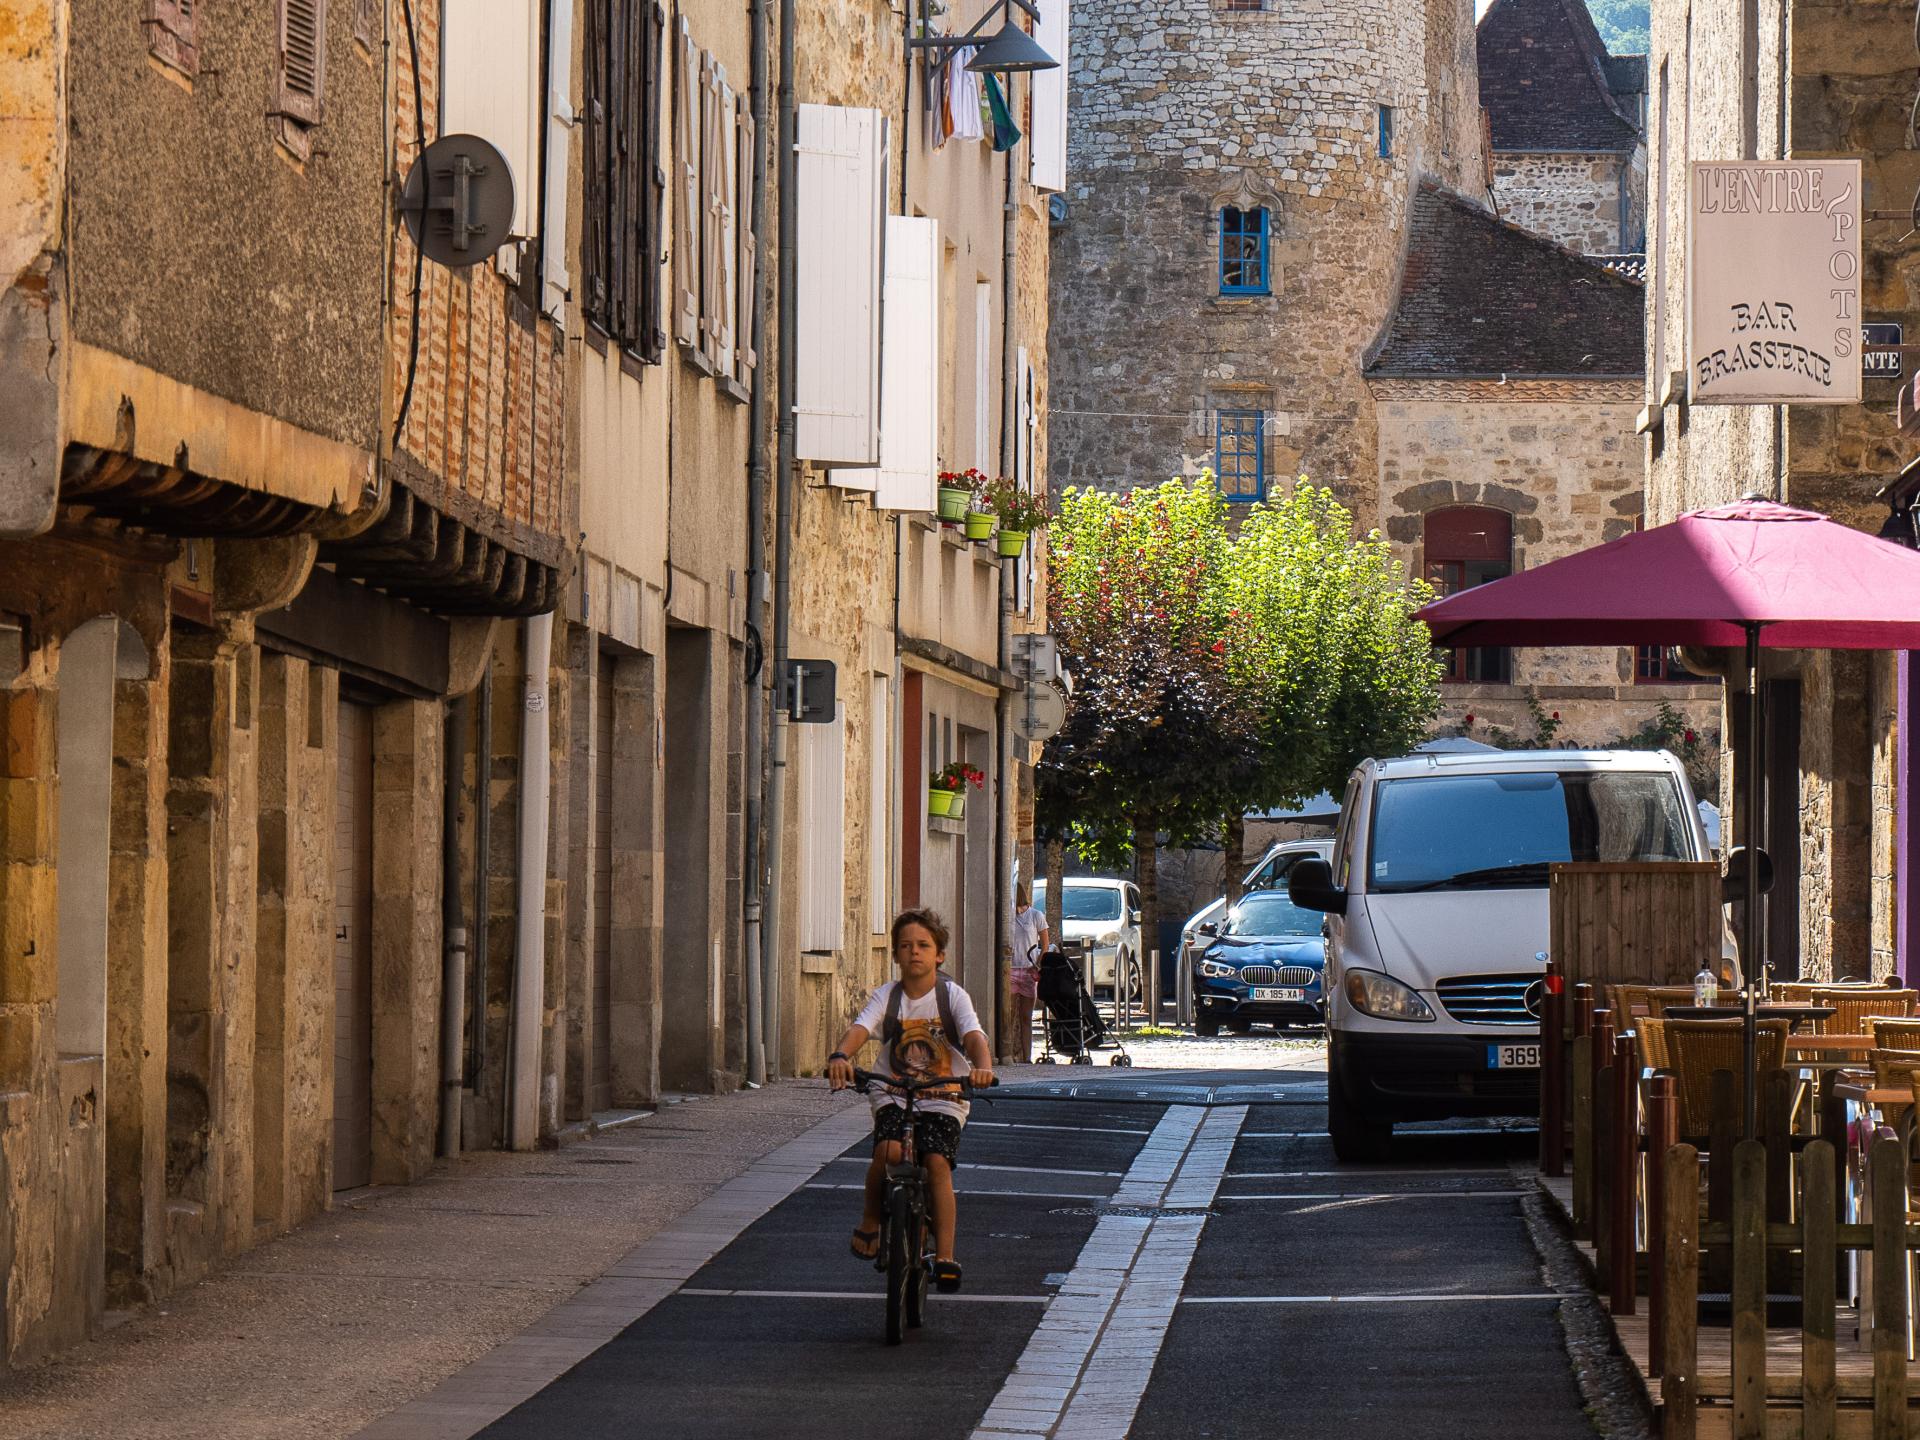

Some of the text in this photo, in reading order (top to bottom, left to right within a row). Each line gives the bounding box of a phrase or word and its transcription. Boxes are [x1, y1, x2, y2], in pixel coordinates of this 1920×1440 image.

[1699, 168, 1824, 214] L'ENTRE
[1829, 212, 1857, 358] POTS
[1731, 300, 1797, 333] BAR
[1696, 340, 1832, 391] BRASSERIE
[1504, 1047, 1540, 1066] 369
